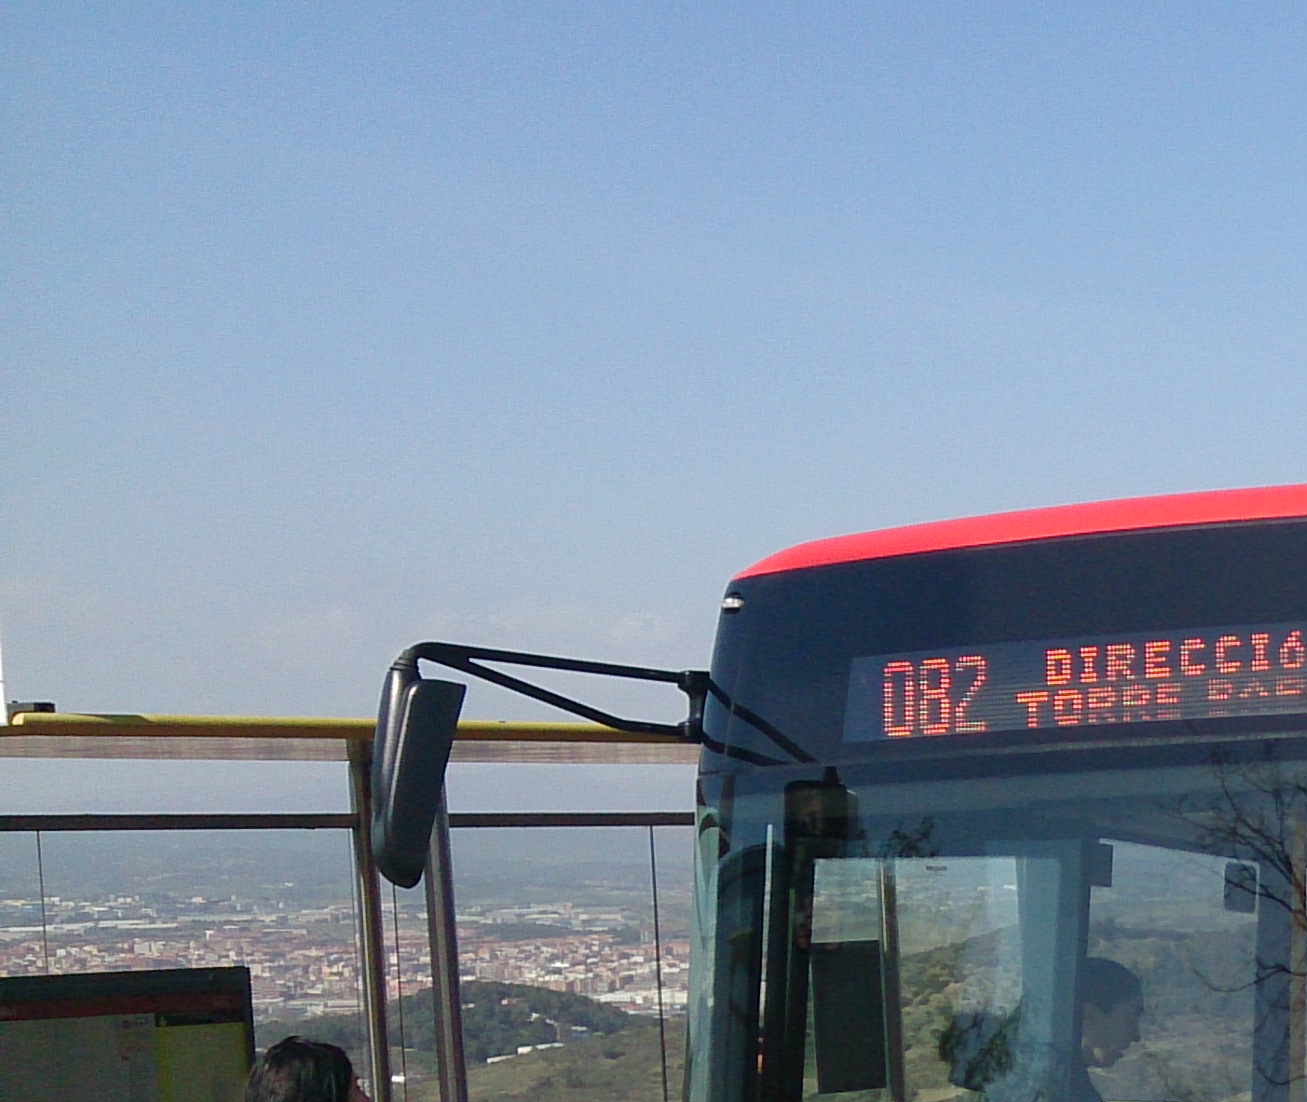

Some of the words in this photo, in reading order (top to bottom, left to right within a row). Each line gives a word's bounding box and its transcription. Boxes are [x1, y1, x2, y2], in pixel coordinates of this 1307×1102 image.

[1045, 630, 1306, 687] DIRECCIÓ
[883, 655, 987, 737] 082
[1016, 680, 1182, 729] TORRE
